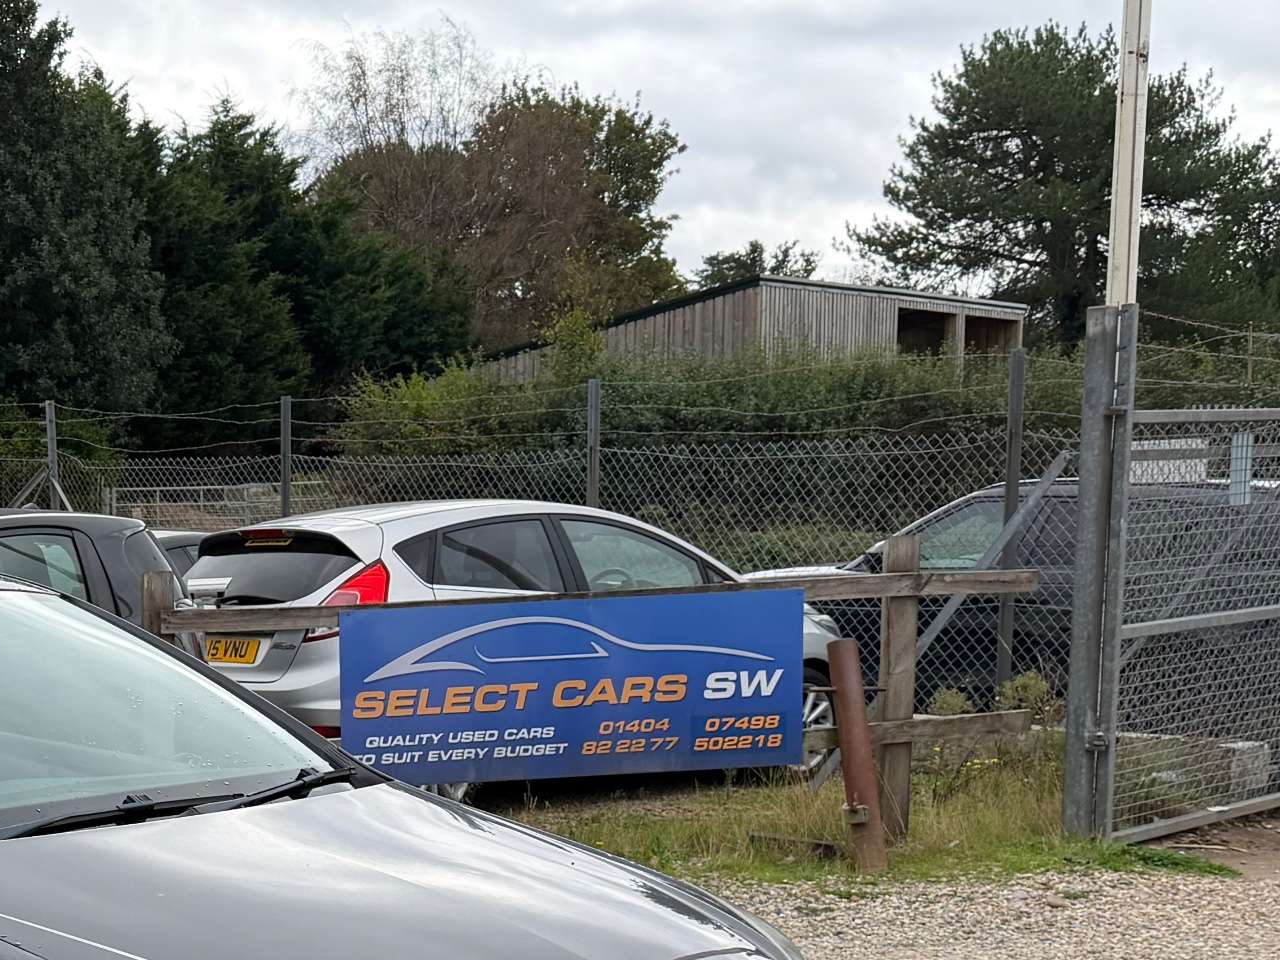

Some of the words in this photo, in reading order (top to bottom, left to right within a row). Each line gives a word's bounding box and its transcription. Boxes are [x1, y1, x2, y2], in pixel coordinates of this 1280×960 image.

[223, 640, 251, 658] VNU
[352, 682, 539, 719] SELECT
[552, 674, 688, 708] CARS
[703, 669, 785, 699] SW
[599, 718, 670, 735] 01404
[705, 715, 781, 732] 07498
[365, 732, 444, 749] QUALITY
[448, 729, 499, 744] USED
[503, 726, 555, 741] CARS
[694, 733, 783, 751] 502218
[380, 751, 424, 765] SUIT
[427, 747, 490, 763] EVERY
[493, 742, 569, 759] BUDGET
